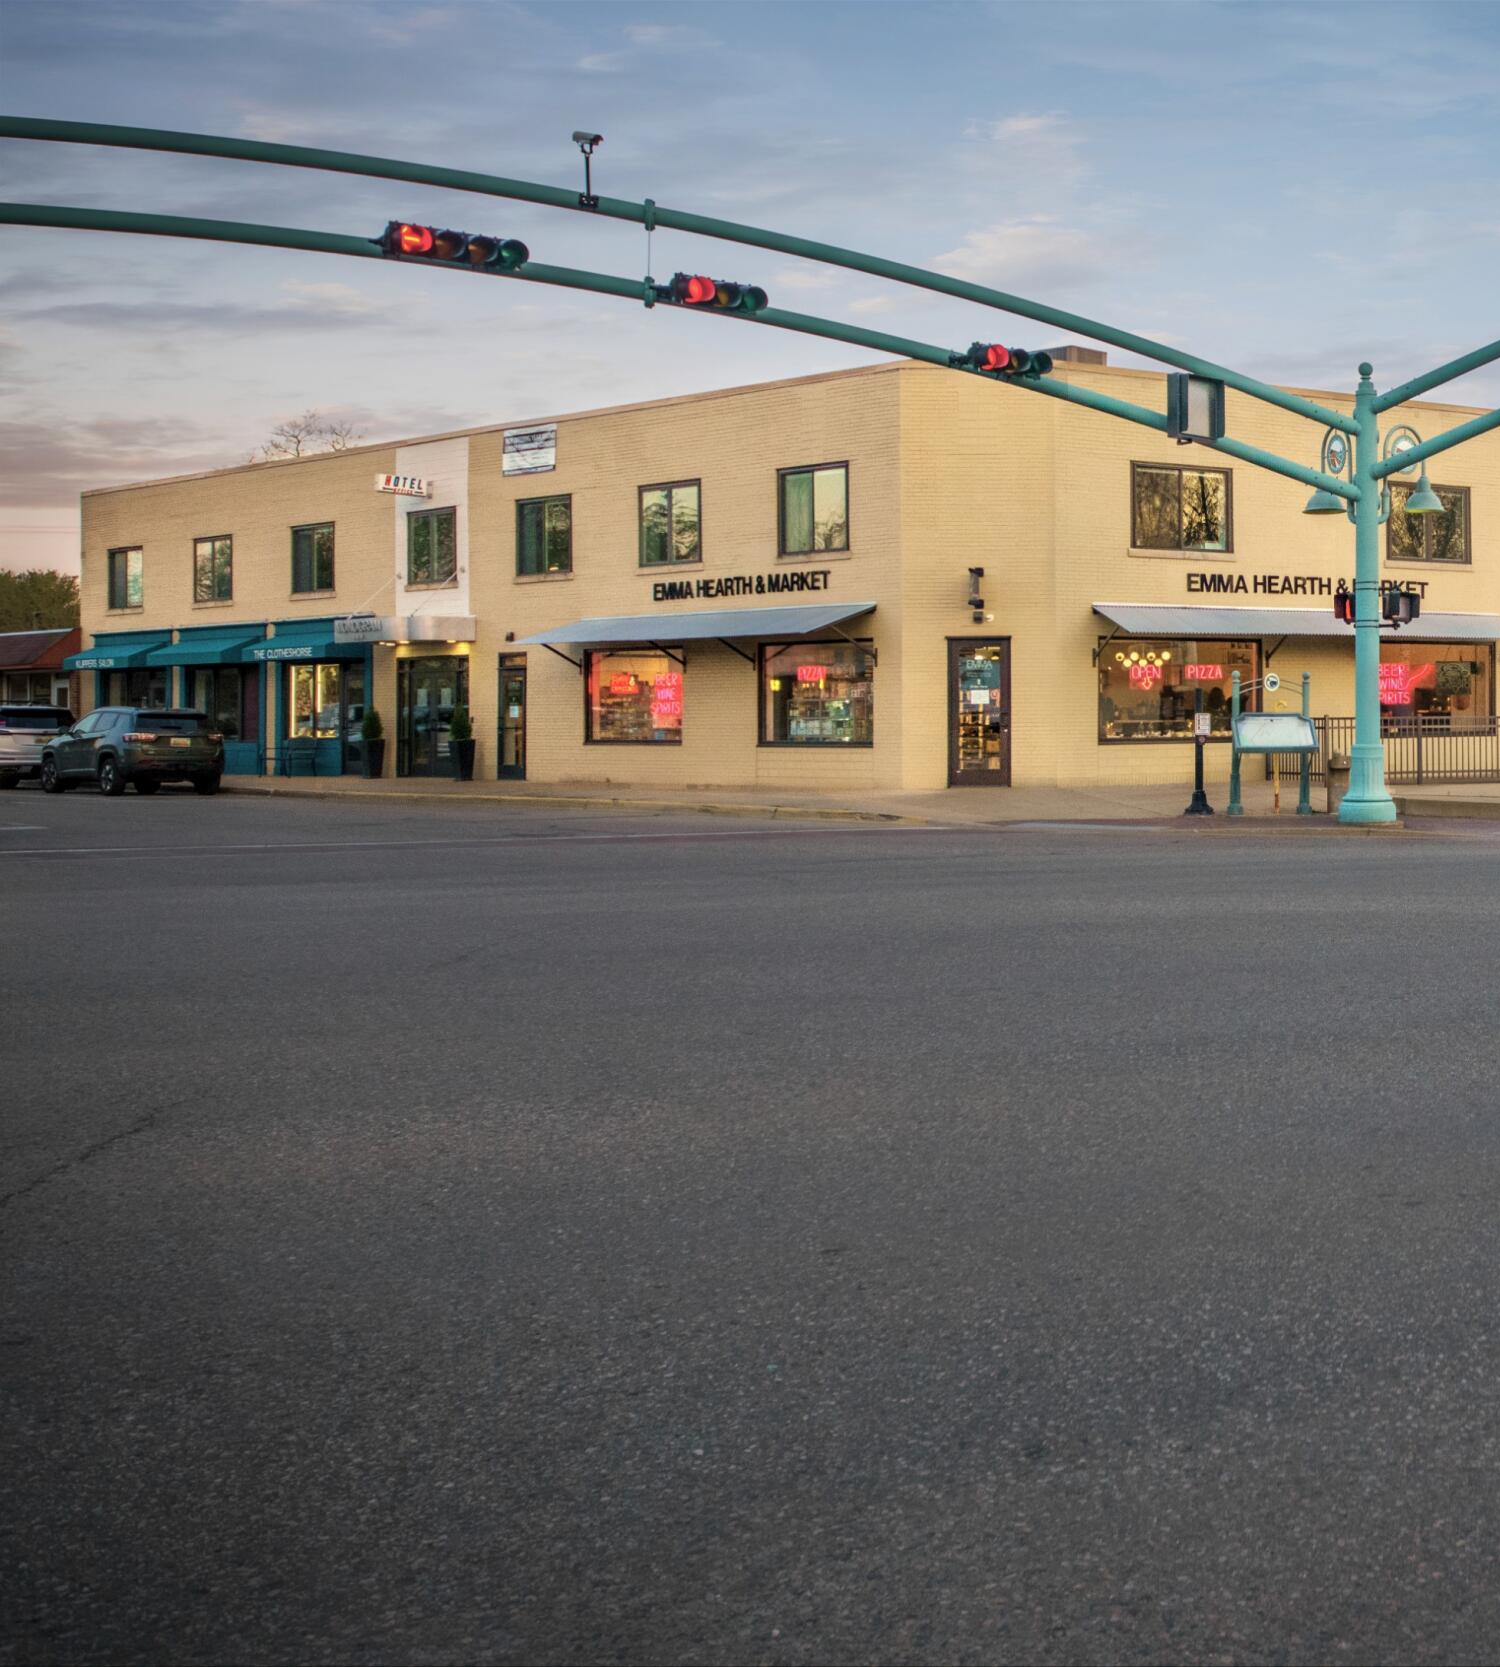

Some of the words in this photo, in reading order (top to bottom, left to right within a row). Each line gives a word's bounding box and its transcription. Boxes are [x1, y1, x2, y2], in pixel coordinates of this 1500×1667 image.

[384, 474, 423, 490] HOTEL
[653, 580, 694, 601] EMMA
[696, 576, 752, 598] HEARTH
[755, 575, 766, 594] &
[767, 570, 831, 593] MARKET
[1186, 573, 1249, 594] EMMA
[1253, 574, 1332, 596] HEARTH
[1336, 577, 1349, 595] &
[1352, 577, 1429, 599] RKET
[253, 649, 265, 660] THE
[266, 647, 313, 659] CLOTHESHORSE
[797, 665, 828, 681] PIZZA
[1130, 664, 1162, 680] OPEN
[1186, 663, 1223, 680] PIZZA
[655, 673, 679, 687] BEER
[1378, 691, 1411, 704] PIRITS
[650, 701, 681, 715] SPIRITS
